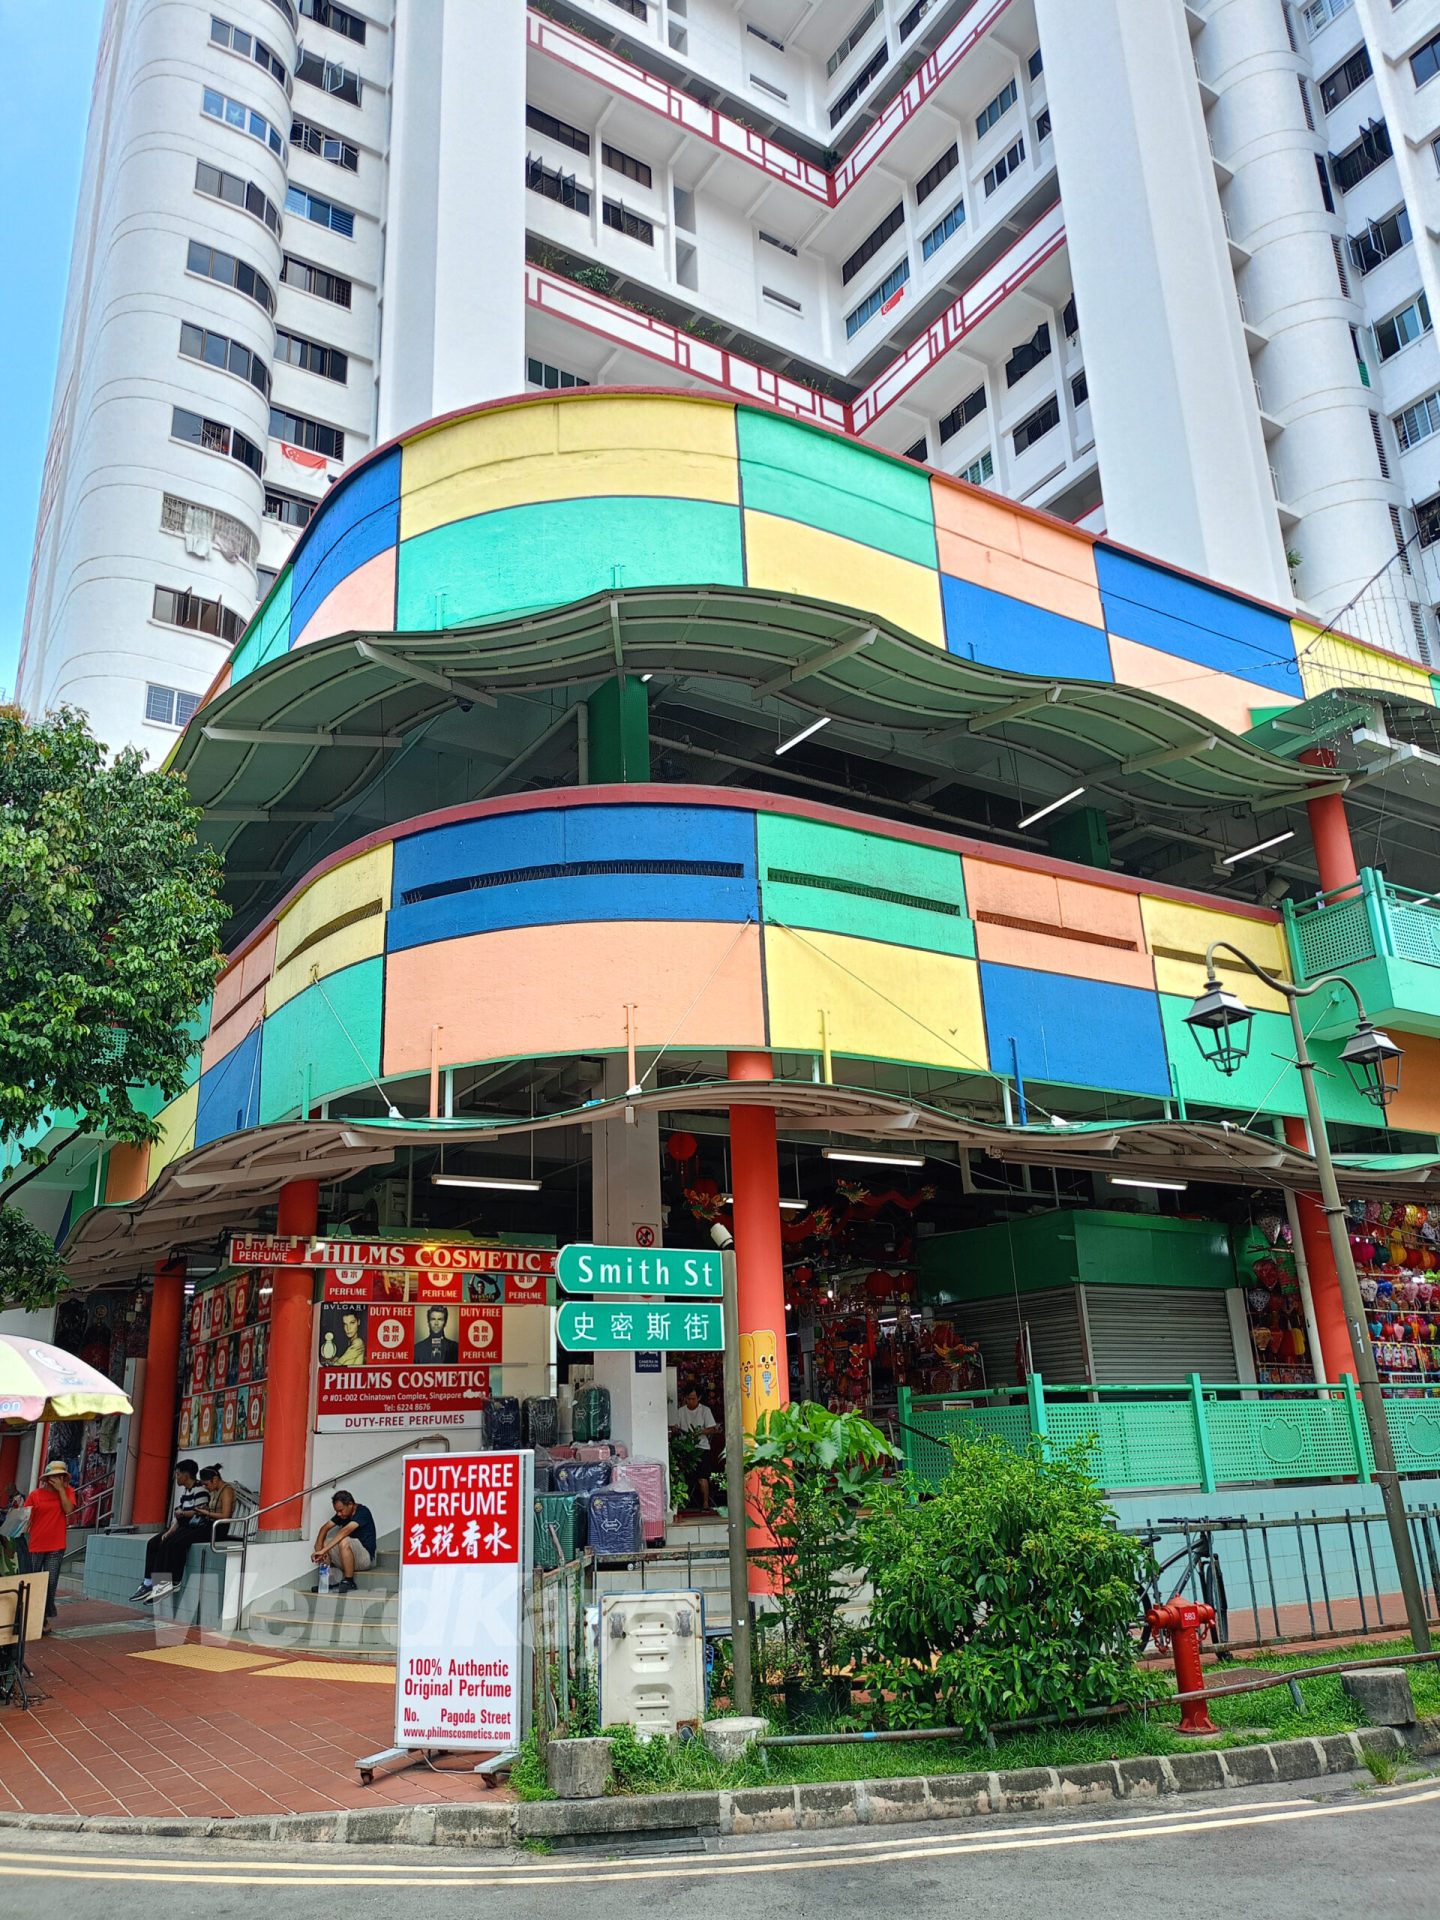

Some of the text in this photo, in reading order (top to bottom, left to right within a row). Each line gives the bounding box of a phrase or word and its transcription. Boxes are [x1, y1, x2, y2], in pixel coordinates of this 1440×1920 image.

[236, 1241, 291, 1251] DTY-REE
[239, 1251, 287, 1262] PERFUME
[304, 1243, 405, 1265] PHILMS
[415, 1248, 542, 1271] COSMETIC
[578, 1255, 670, 1285] Smith
[684, 1259, 713, 1287] St
[329, 1287, 368, 1296] PERFUME
[422, 1289, 458, 1298] PERFUME
[508, 1291, 542, 1300] PERFUME
[370, 1306, 413, 1316] DUTY FREE
[460, 1307, 501, 1317] DUTY FREE
[572, 1311, 710, 1341] 史密斯街
[371, 1351, 409, 1360] PERFUME
[462, 1351, 498, 1359] PERFUME
[324, 1370, 485, 1390] PHILMS COSMETIC
[322, 1394, 329, 1402] @
[330, 1393, 358, 1402] #01-002
[359, 1393, 396, 1401] Chinatown
[397, 1391, 428, 1401] Complex,
[429, 1391, 461, 1402] Singapore
[396, 1403, 413, 1411] 6224
[414, 1403, 431, 1411] 8676
[345, 1414, 465, 1427] DUTY-FREE PERFUMES
[409, 1463, 514, 1491] DUTY-FREE
[414, 1490, 508, 1518] PERFUME
[408, 1519, 513, 1559] 免税香水
[409, 1658, 509, 1677] 100% Authentic
[404, 1678, 512, 1700] Original Perfume
[403, 1707, 511, 1726] No. Pagoda Street
[403, 1726, 511, 1741] www.philmscosmetics.com
